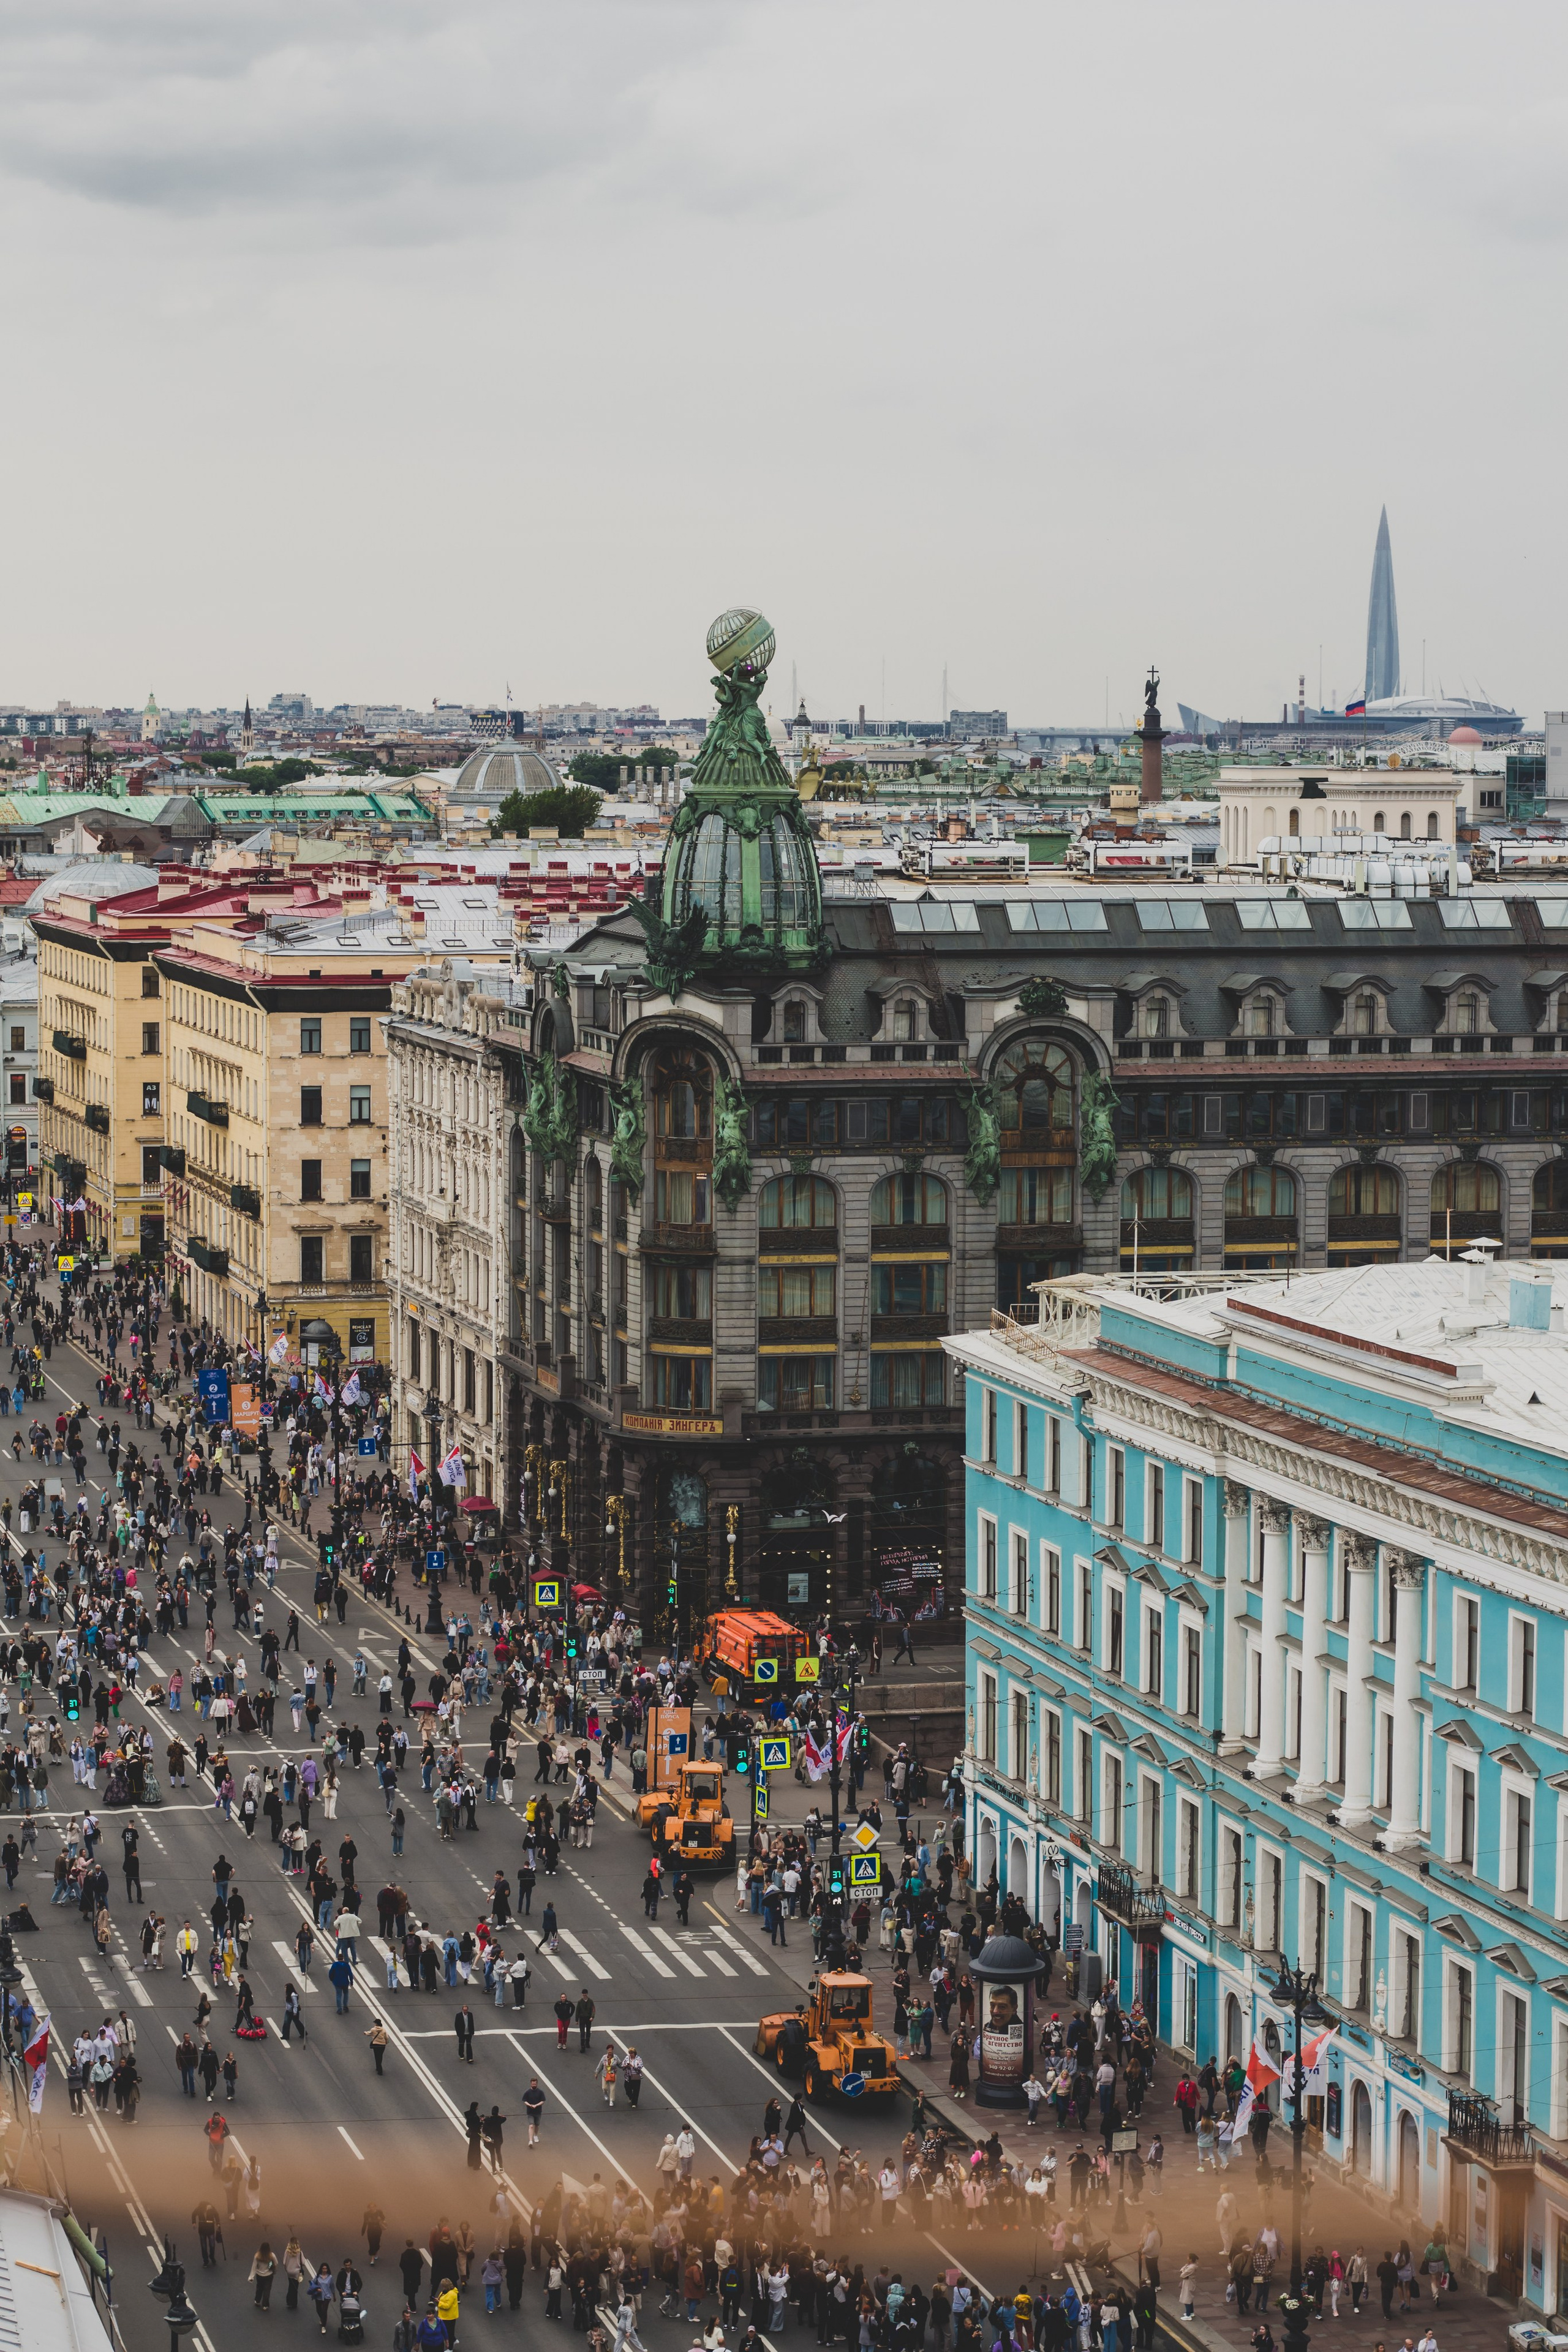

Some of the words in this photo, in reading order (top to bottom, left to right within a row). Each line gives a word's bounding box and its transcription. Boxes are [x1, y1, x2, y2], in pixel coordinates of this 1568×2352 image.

[625, 1415, 663, 1430] КОМПАНІЯ
[669, 1420, 716, 1433] ЗИНГЕРЪ
[445, 1461, 456, 1483] ПАРУСА
[453, 1459, 462, 1476] АЛЫЕ
[854, 1888, 878, 1897] СТОП
[982, 2031, 1009, 2042] Брачное
